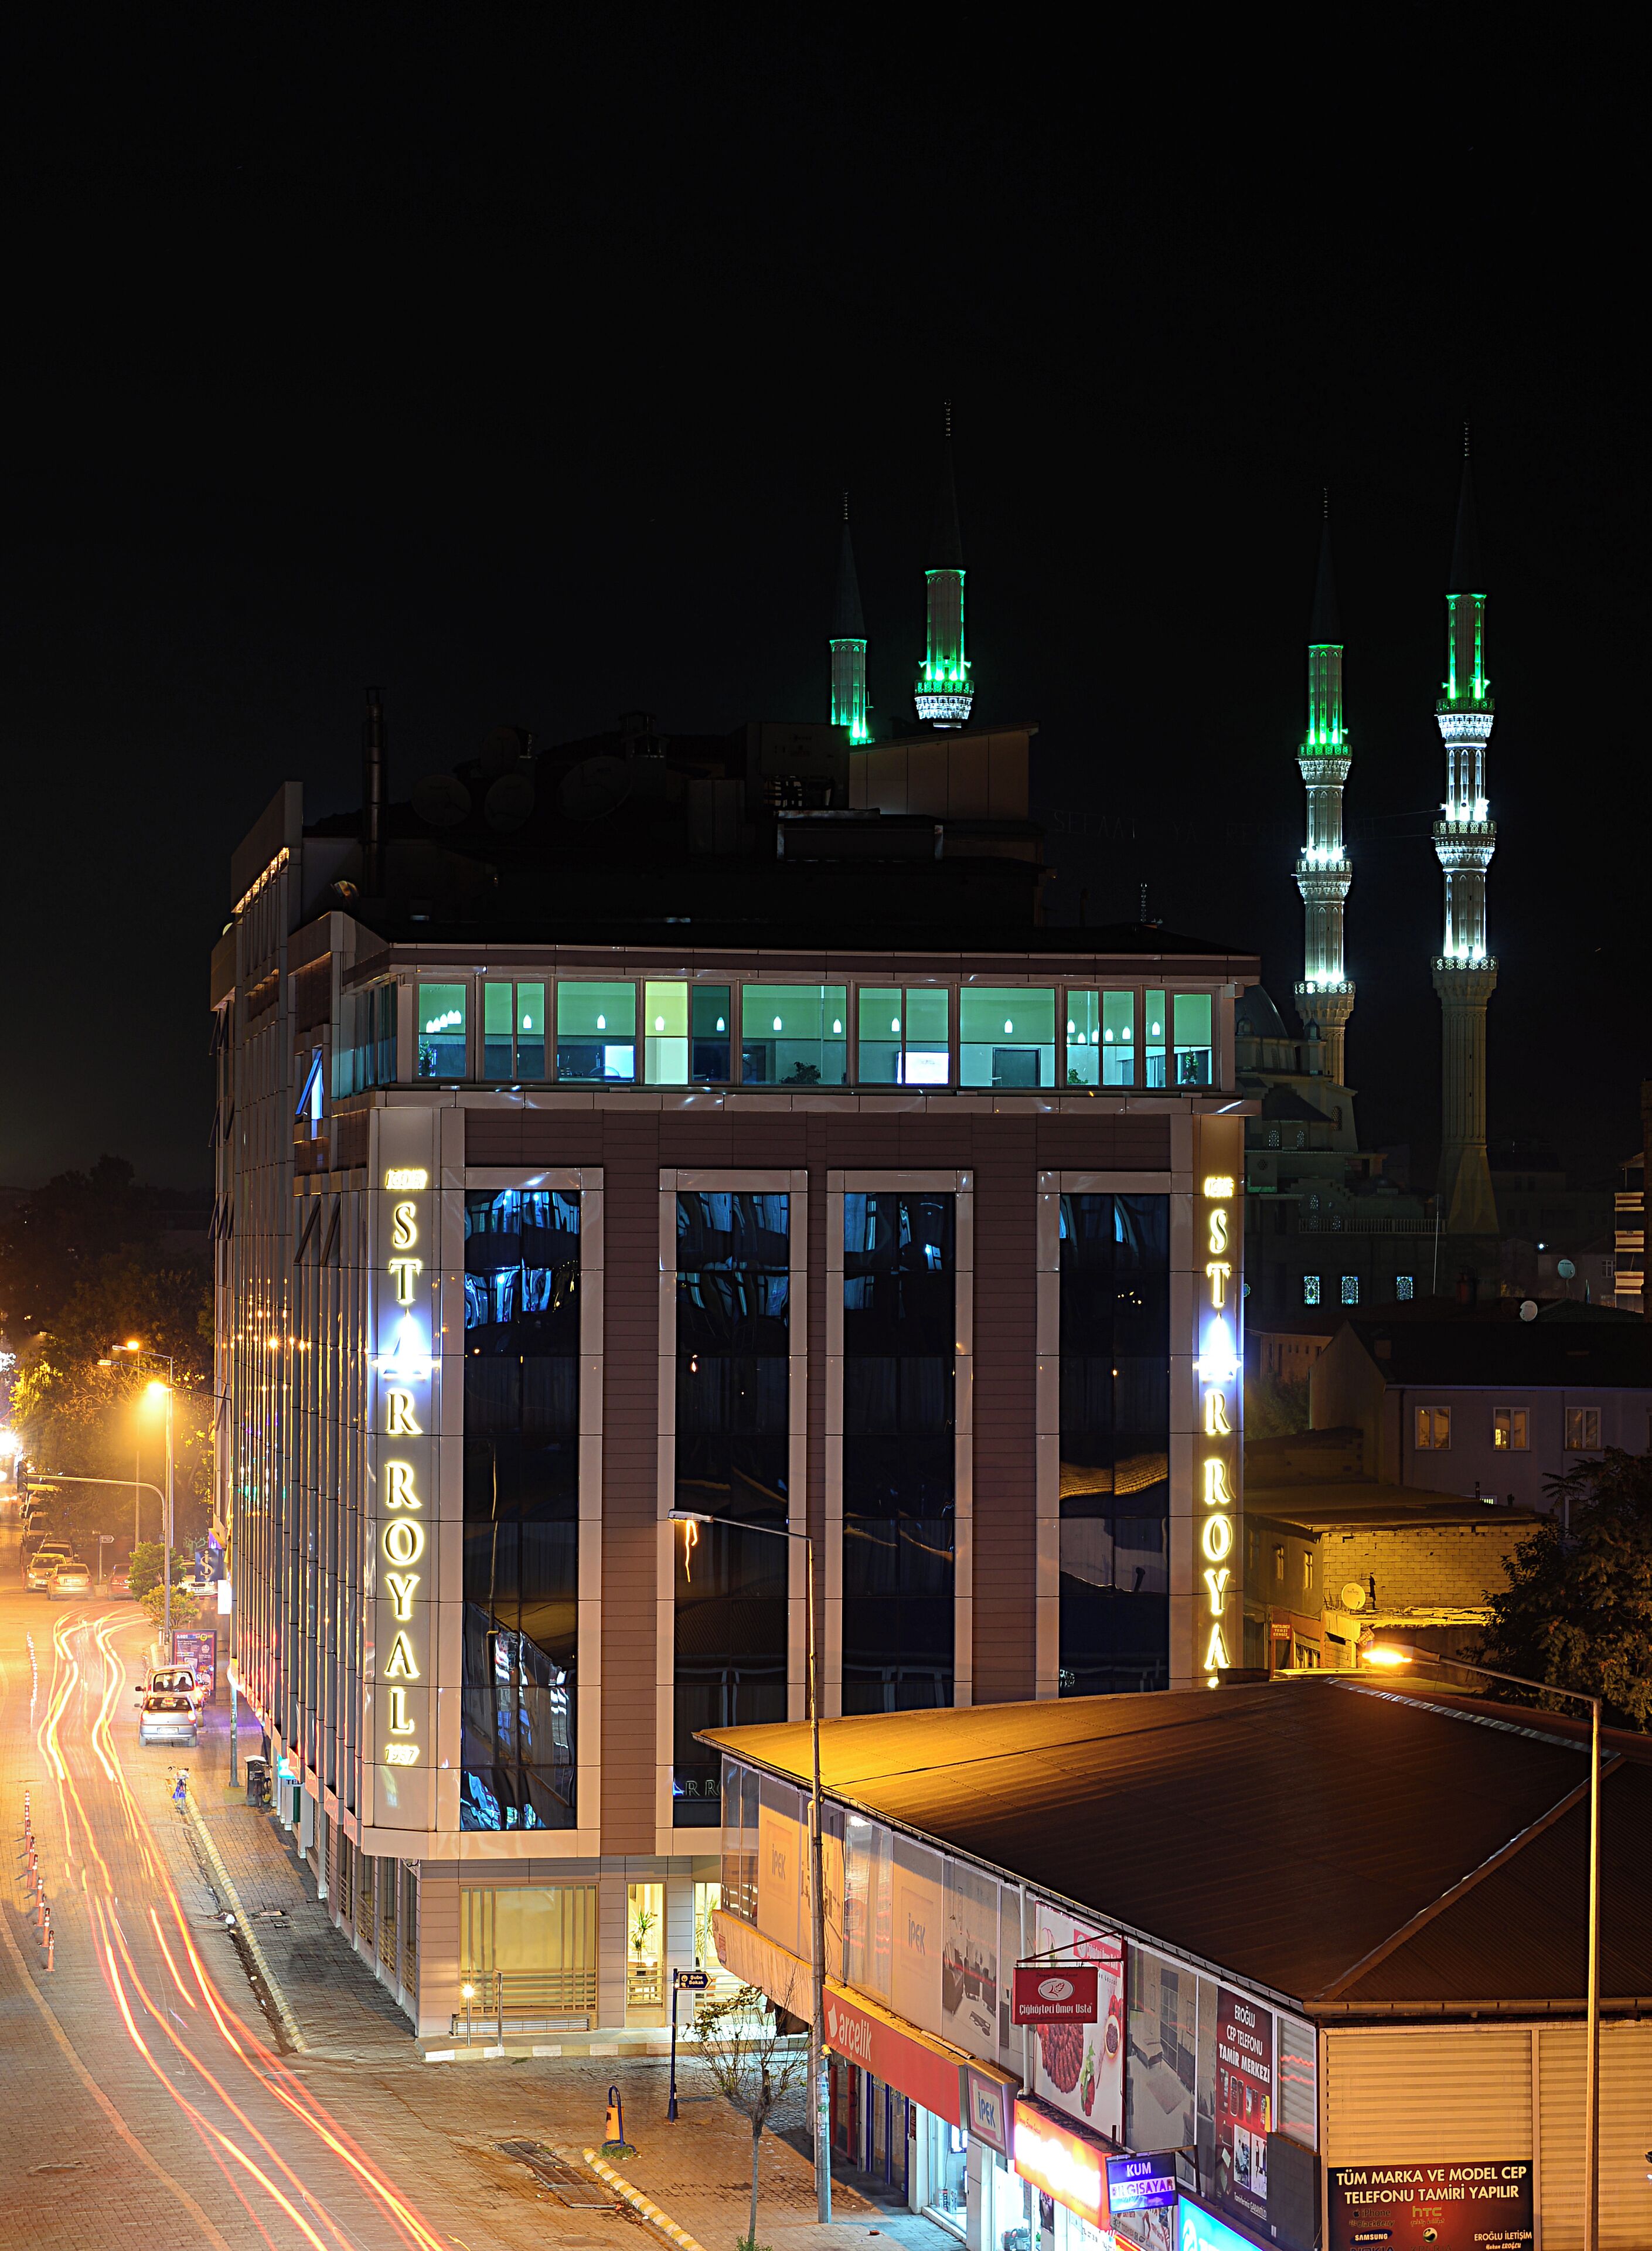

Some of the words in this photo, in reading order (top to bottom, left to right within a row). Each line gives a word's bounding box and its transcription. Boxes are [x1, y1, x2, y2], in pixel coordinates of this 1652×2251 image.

[384, 1460, 424, 1735] ROYAL
[1020, 2004, 1054, 2015] Çiğköfteci
[1055, 2002, 1073, 2014] Ömer
[1075, 2004, 1092, 2014] Usta
[1235, 2005, 1255, 2028] EROĞLU
[839, 2013, 871, 2062] arçelik
[1227, 2025, 1237, 2042] CEP
[1237, 2029, 1262, 2056] TELEFONU
[1219, 2043, 1239, 2068] TAMİR
[1241, 2055, 1270, 2083] MERKEZİ
[1126, 2162, 1152, 2177] KUM
[1336, 2169, 1367, 2185] TÜM
[1371, 2170, 1423, 2184] MARKA
[1427, 2169, 1445, 2182] VE
[1449, 2167, 1498, 2181] MODEL
[1501, 2166, 1527, 2179] CEP
[1344, 2189, 1414, 2204] TELEFONU
[1418, 2184, 1464, 2201] TAMİRİ
[1469, 2185, 1519, 2199] YAPILIR
[1361, 2209, 1391, 2218] iPhone
[1474, 2231, 1503, 2241] EROĞLU
[1505, 2229, 1532, 2240] İLETİŞİM
